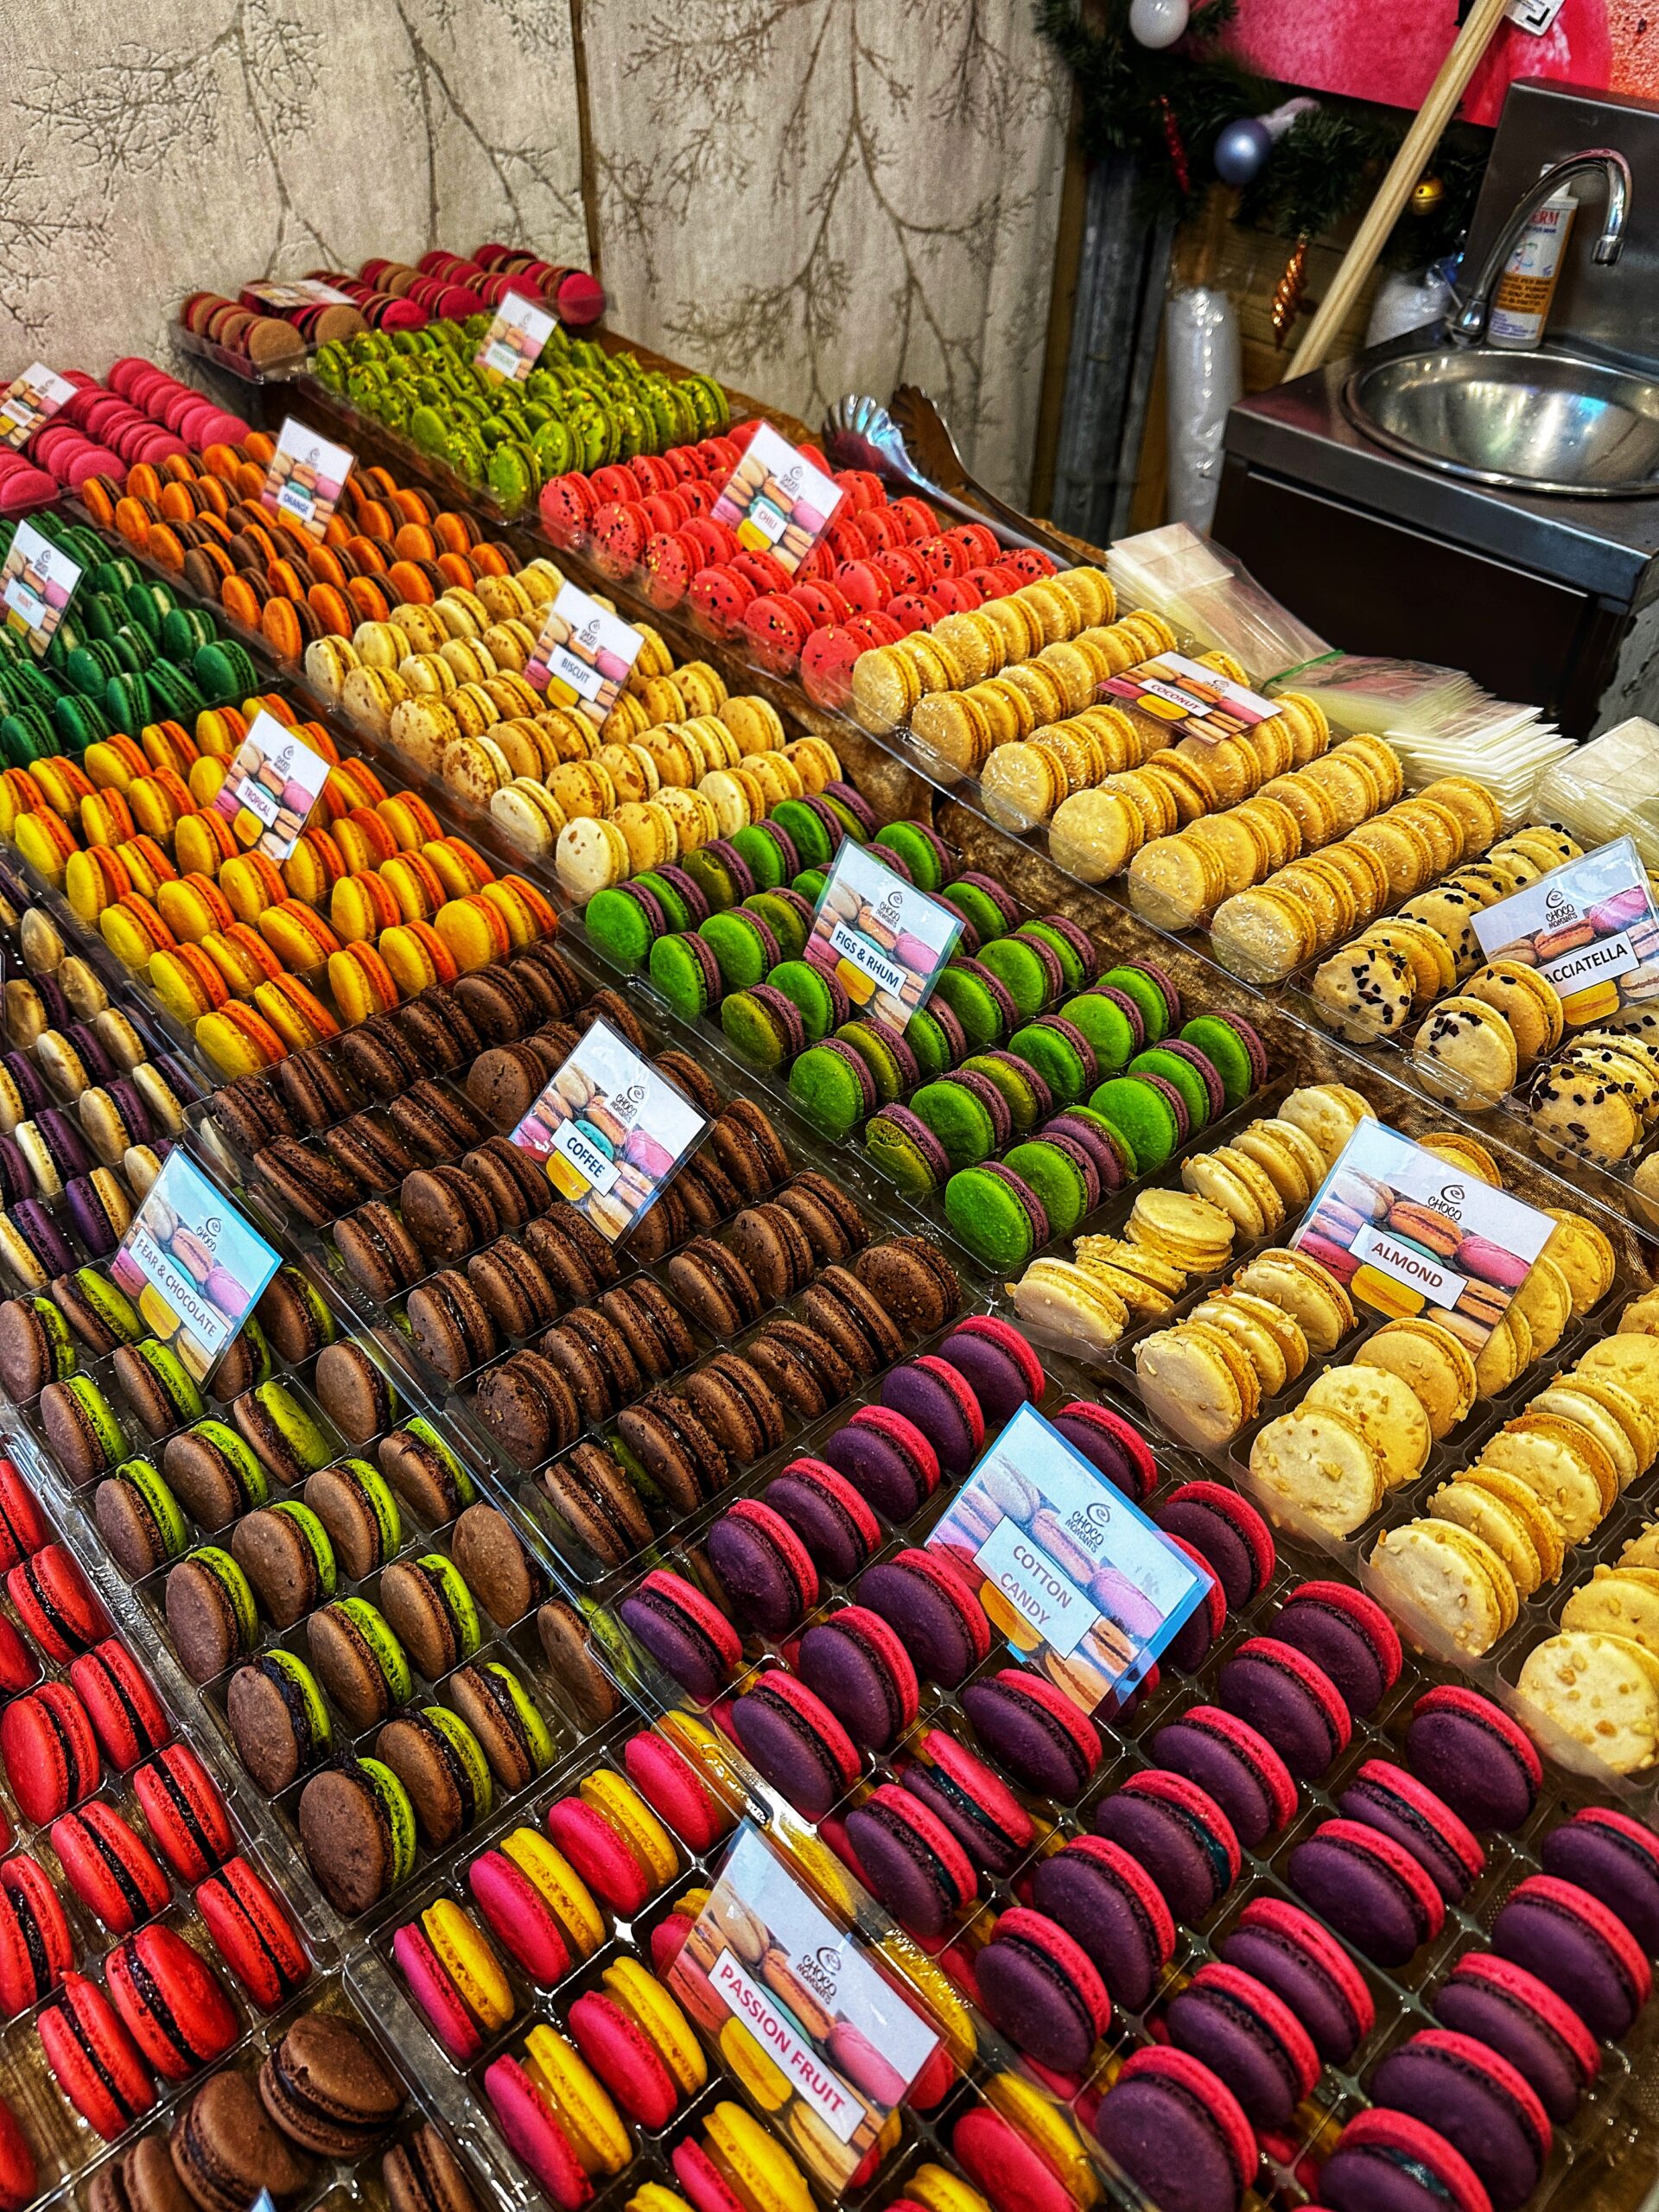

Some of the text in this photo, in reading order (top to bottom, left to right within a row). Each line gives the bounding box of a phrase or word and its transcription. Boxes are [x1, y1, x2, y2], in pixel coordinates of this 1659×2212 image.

[759, 511, 779, 530] CHILI
[561, 657, 591, 684] BISCUIT
[1151, 684, 1201, 710] COCONUT
[245, 786, 270, 817] TROPICAL
[880, 901, 900, 922] CHOCO
[1546, 904, 1574, 922] CHOCO
[836, 931, 899, 988] FIGS & RHUM
[615, 1094, 638, 1116] CHOCO
[567, 1137, 607, 1179] COFFEE
[1427, 1196, 1462, 1220] CHOCO
[196, 1226, 217, 1252] CHOCO
[1371, 1242, 1443, 1288] ALMOND
[157, 1264, 166, 1279] &
[165, 1274, 218, 1338] CHOCOLATE
[1072, 1510, 1104, 1545] CHOCO
[1013, 1544, 1072, 1609] COTTON
[1000, 1571, 1052, 1626] CANDY
[802, 1954, 838, 1996] CHOCO
[720, 1963, 847, 2113] PASSION FRUIT
